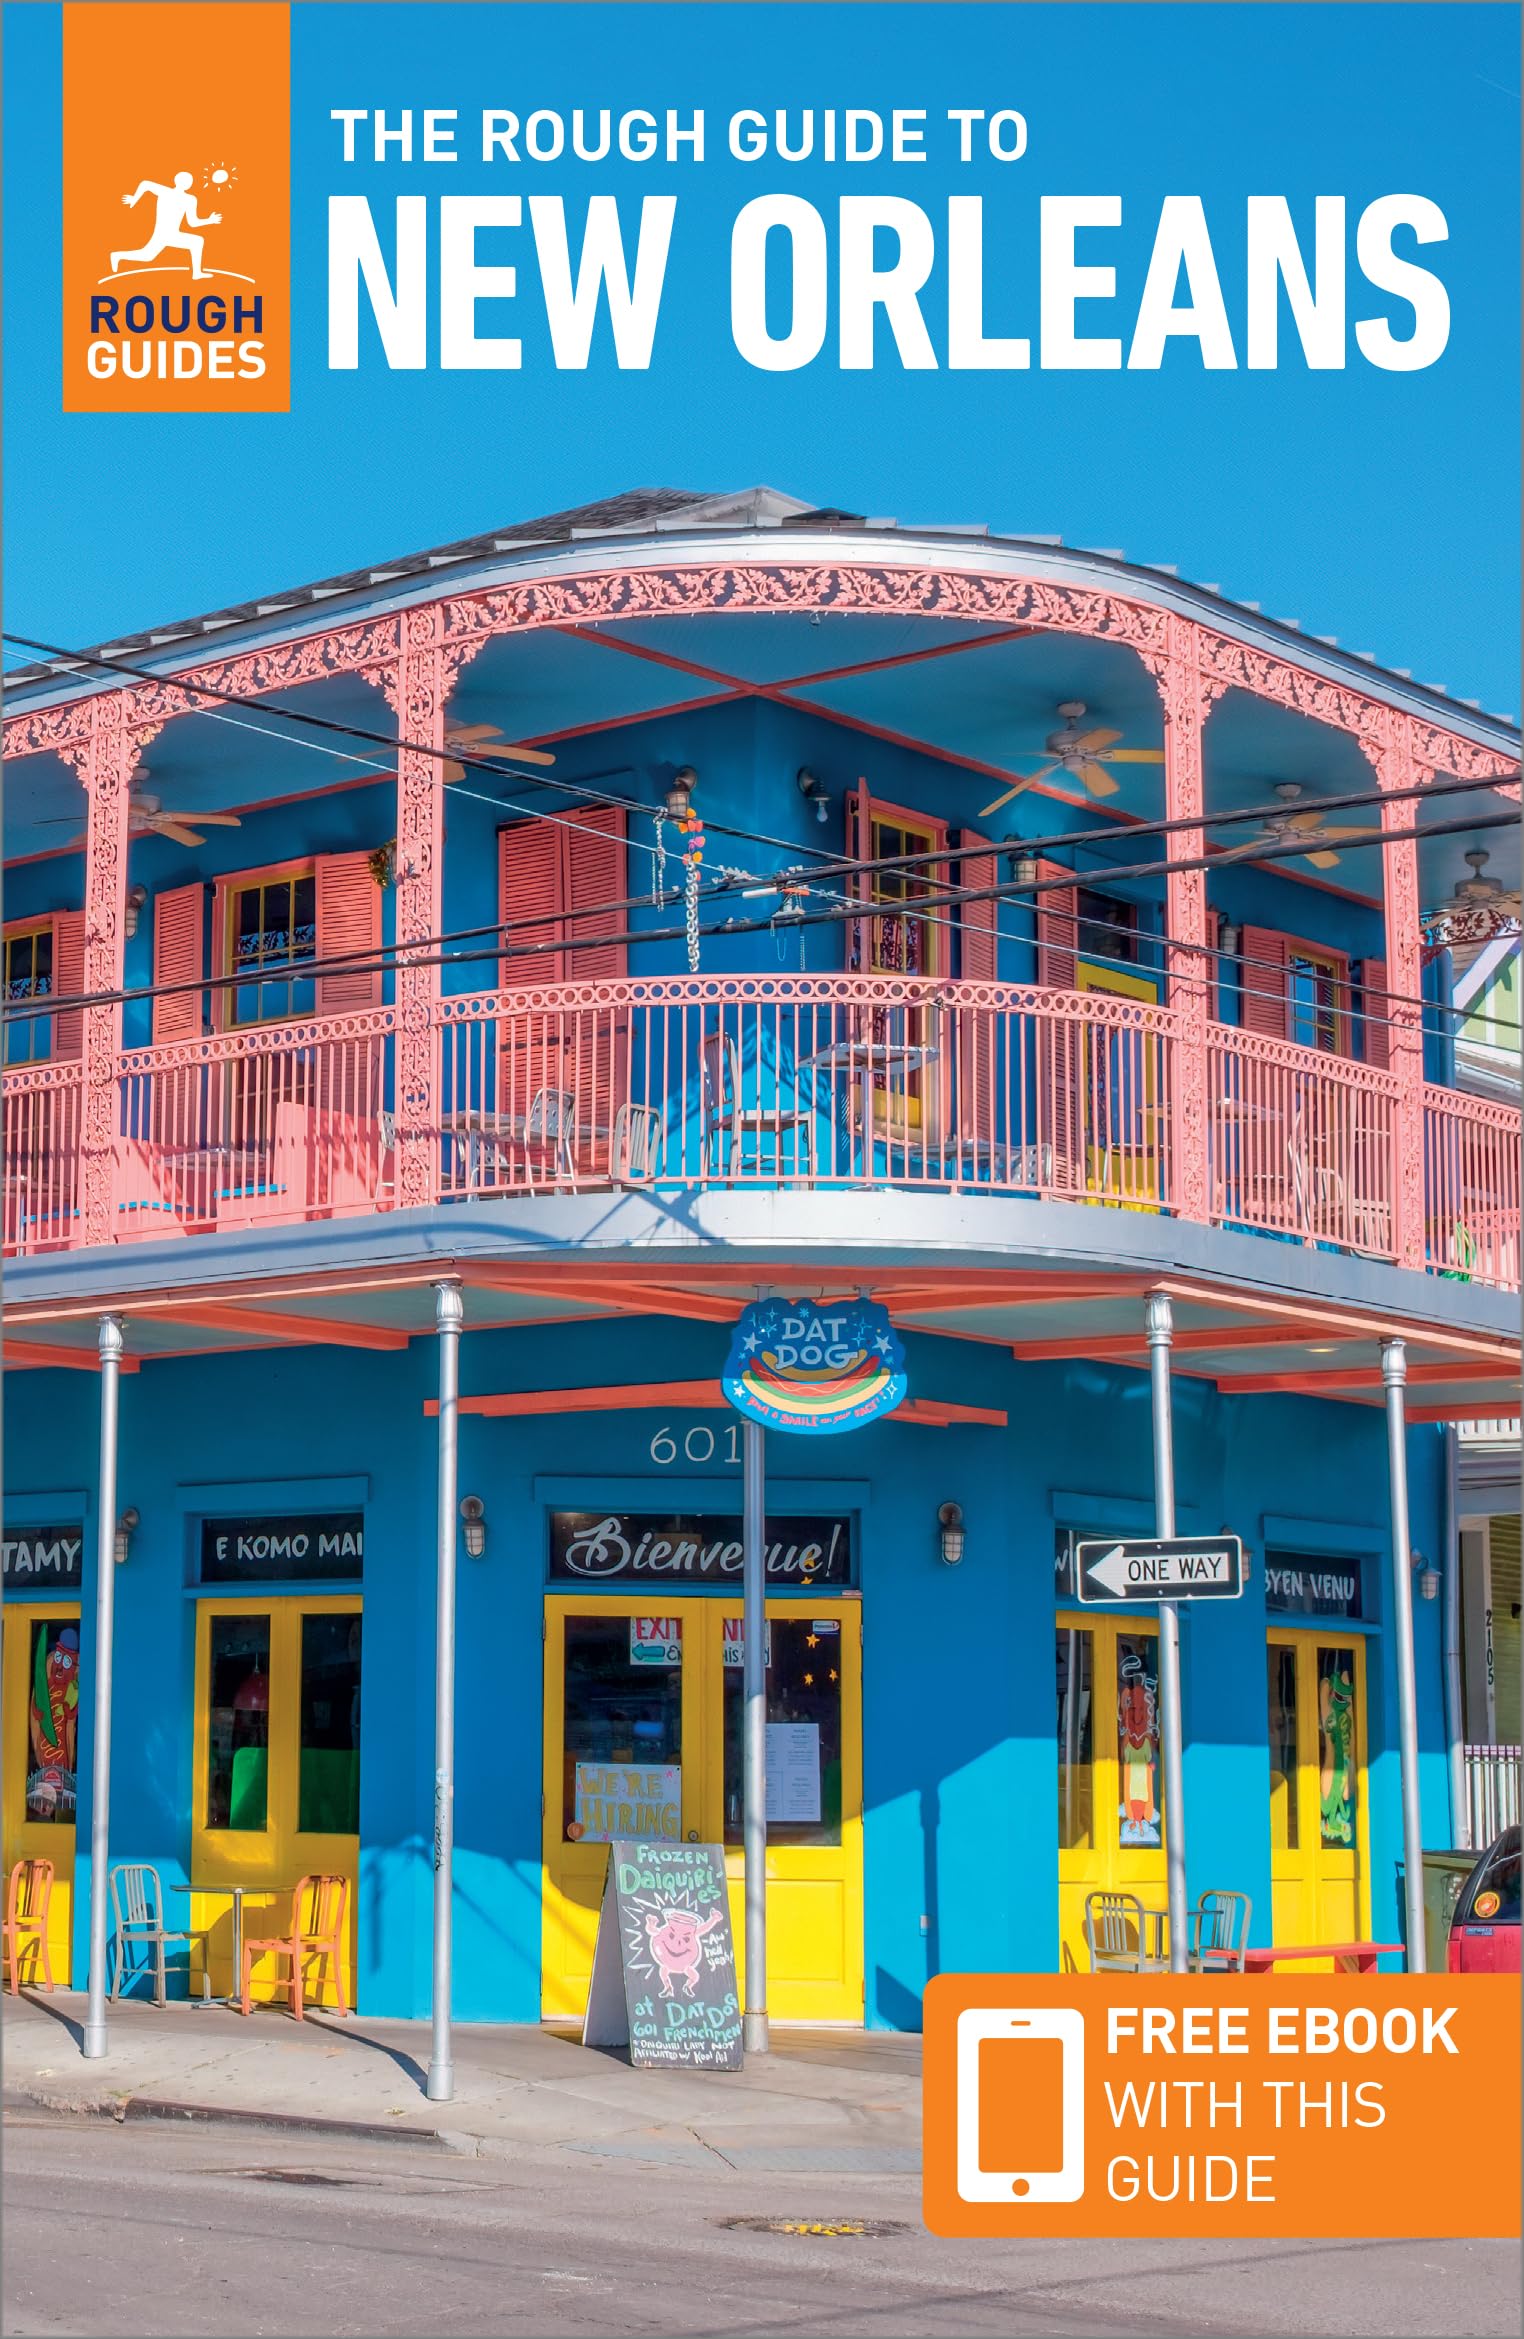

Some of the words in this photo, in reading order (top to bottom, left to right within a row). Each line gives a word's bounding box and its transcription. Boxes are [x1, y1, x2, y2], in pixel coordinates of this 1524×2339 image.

[781, 1317, 847, 1342] DAT
[774, 1343, 859, 1370] DOG
[779, 1413, 819, 1427] SMILE
[650, 1425, 742, 1464] 601
[216, 1536, 229, 1561] E
[237, 1534, 309, 1561] KOMO
[318, 1532, 363, 1557] MAI
[565, 1516, 842, 1577] Bienveue!
[1128, 1559, 1170, 1582] ONE
[1177, 1556, 1222, 1580] WAY
[1309, 1573, 1355, 1601] VENU
[1485, 1608, 1495, 1686] 2105
[579, 1767, 663, 1799] WE'RE
[581, 1798, 680, 1840] HIRING
[636, 1844, 709, 1865] FROZEN
[634, 1995, 655, 2017] at
[665, 2001, 706, 2028] DAT
[633, 2022, 658, 2038] 601
[711, 2040, 735, 2051] NOT
